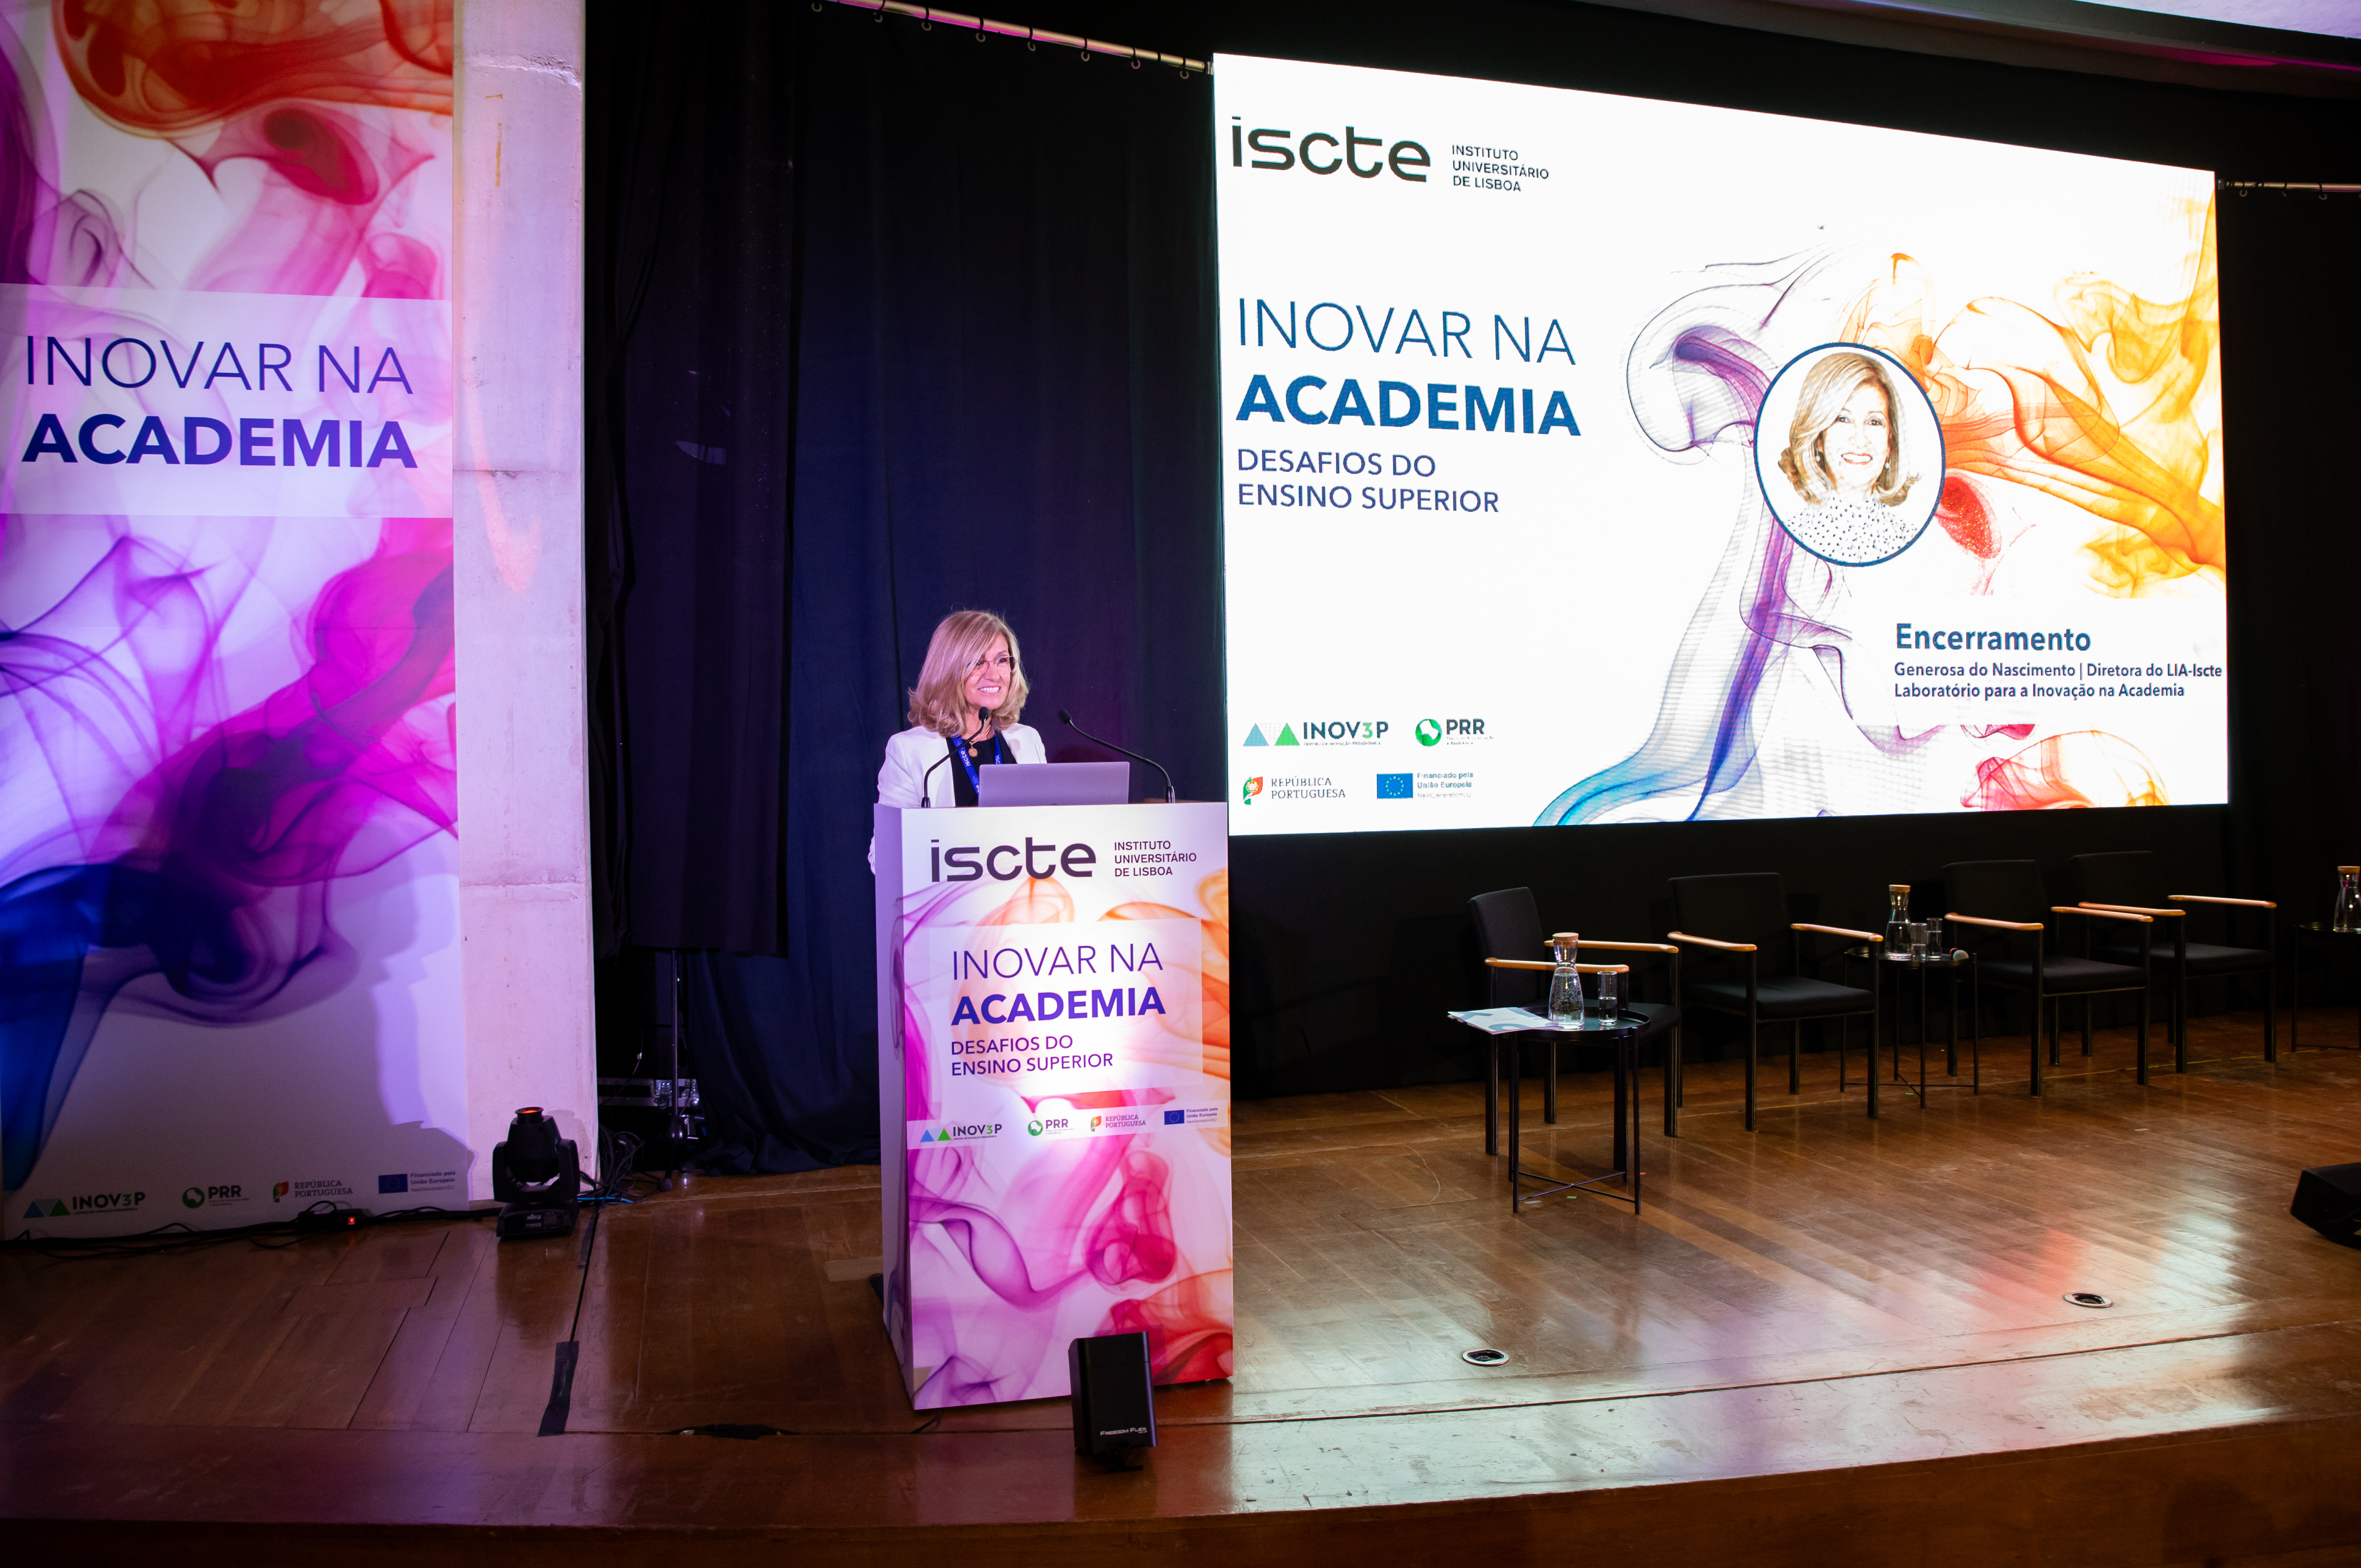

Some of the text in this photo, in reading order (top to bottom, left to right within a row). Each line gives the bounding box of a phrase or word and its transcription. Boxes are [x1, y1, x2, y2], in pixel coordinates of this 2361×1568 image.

[1231, 116, 1431, 183] iscte
[1452, 144, 1518, 161] INSTITUTO
[1452, 160, 1549, 179] UNIVERSITÁRIO
[1453, 175, 1522, 192] DE LISBOA
[1239, 297, 1576, 365] INOVAR NA
[27, 336, 413, 394] INOVAR NA
[1235, 374, 1581, 436] ACADEMIA
[21, 413, 418, 468] ACADEMIA
[1238, 448, 1436, 477] DESAFIOS DO
[1239, 483, 1499, 513] ENSINO SUPERIOR
[1896, 622, 2092, 652] Encerramento
[1894, 661, 1965, 677] Generosa
[1969, 662, 1988, 677] do
[1992, 663, 2076, 677] Nascimento
[2087, 663, 2142, 677] Diretora
[2146, 663, 2163, 677] do
[2167, 663, 2222, 677] LIA-Iscte
[1894, 683, 2185, 701] Laboratório para a Inovação na Academia
[1303, 721, 1389, 740] INOV3P
[1446, 718, 1485, 735] PRR
[961, 751, 970, 766] iscte
[1271, 776, 1332, 787] REPÚBLICA
[1271, 788, 1346, 799] PORTUGUESA
[1114, 840, 1171, 851] INSTITUTO
[931, 837, 1096, 882] iscte
[1114, 851, 1197, 864] UNIVERSITÁRIO
[1114, 866, 1173, 877] DE LISBOA
[953, 942, 1164, 980] INOVAR NA
[951, 987, 1166, 1026] ACADEMIA
[951, 1035, 1073, 1055] DESAFIOS DO
[951, 1053, 1113, 1076] ENSINO SUPERIOR
[953, 1124, 1002, 1136] INOV3P
[1046, 1119, 1068, 1129] PRR
[208, 1185, 242, 1199] PRR
[294, 1180, 342, 1189] REPÚBLICA
[295, 1188, 353, 1197] PORTUGUESA
[72, 1192, 146, 1210] INOV3P
